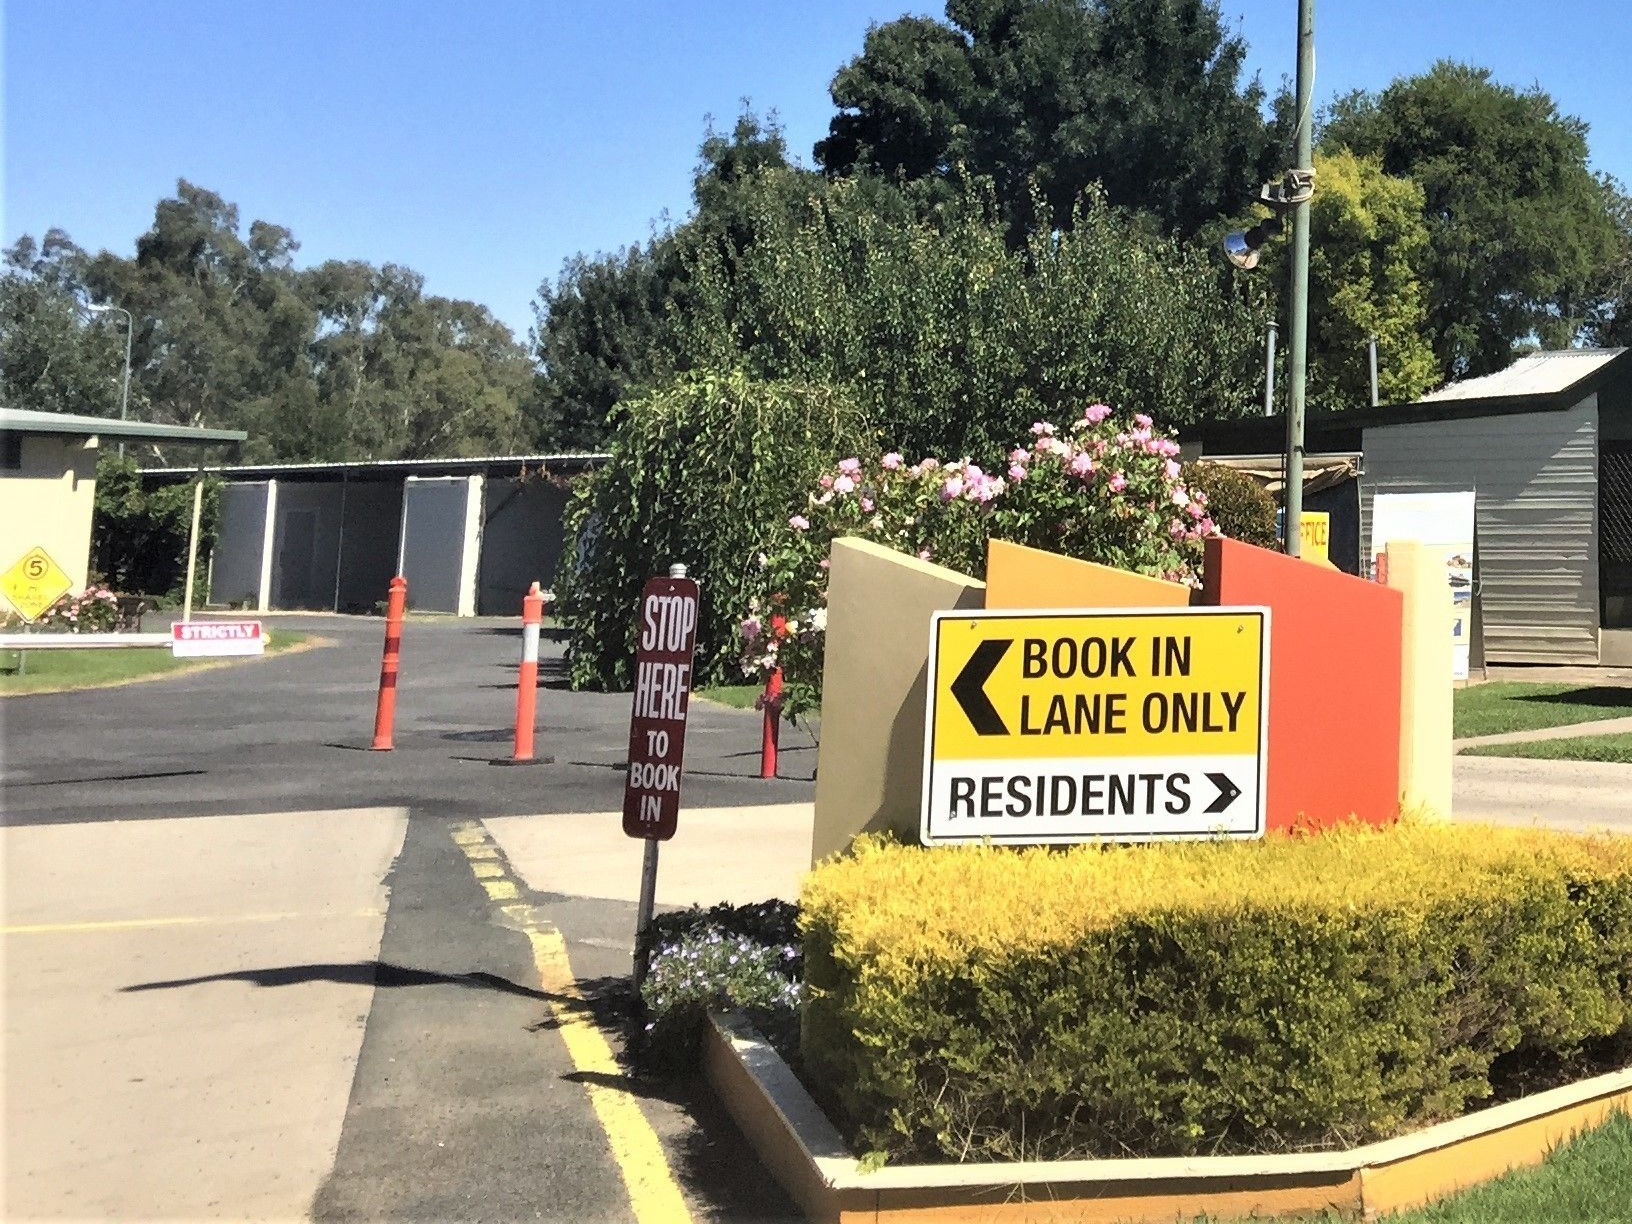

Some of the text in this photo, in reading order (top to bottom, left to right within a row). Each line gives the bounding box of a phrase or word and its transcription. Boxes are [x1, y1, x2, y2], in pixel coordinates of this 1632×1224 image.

[29, 560, 43, 577] 5
[181, 625, 255, 640] STRICTLY
[642, 594, 696, 652] STOP
[1022, 636, 1191, 679] BOOK IN
[635, 661, 690, 720] HERE
[1020, 691, 1247, 736] LANE ONLY
[647, 730, 669, 758] TO
[630, 762, 680, 791] BOOK
[640, 795, 662, 822] IN
[950, 772, 1192, 819] RESIDENTS
